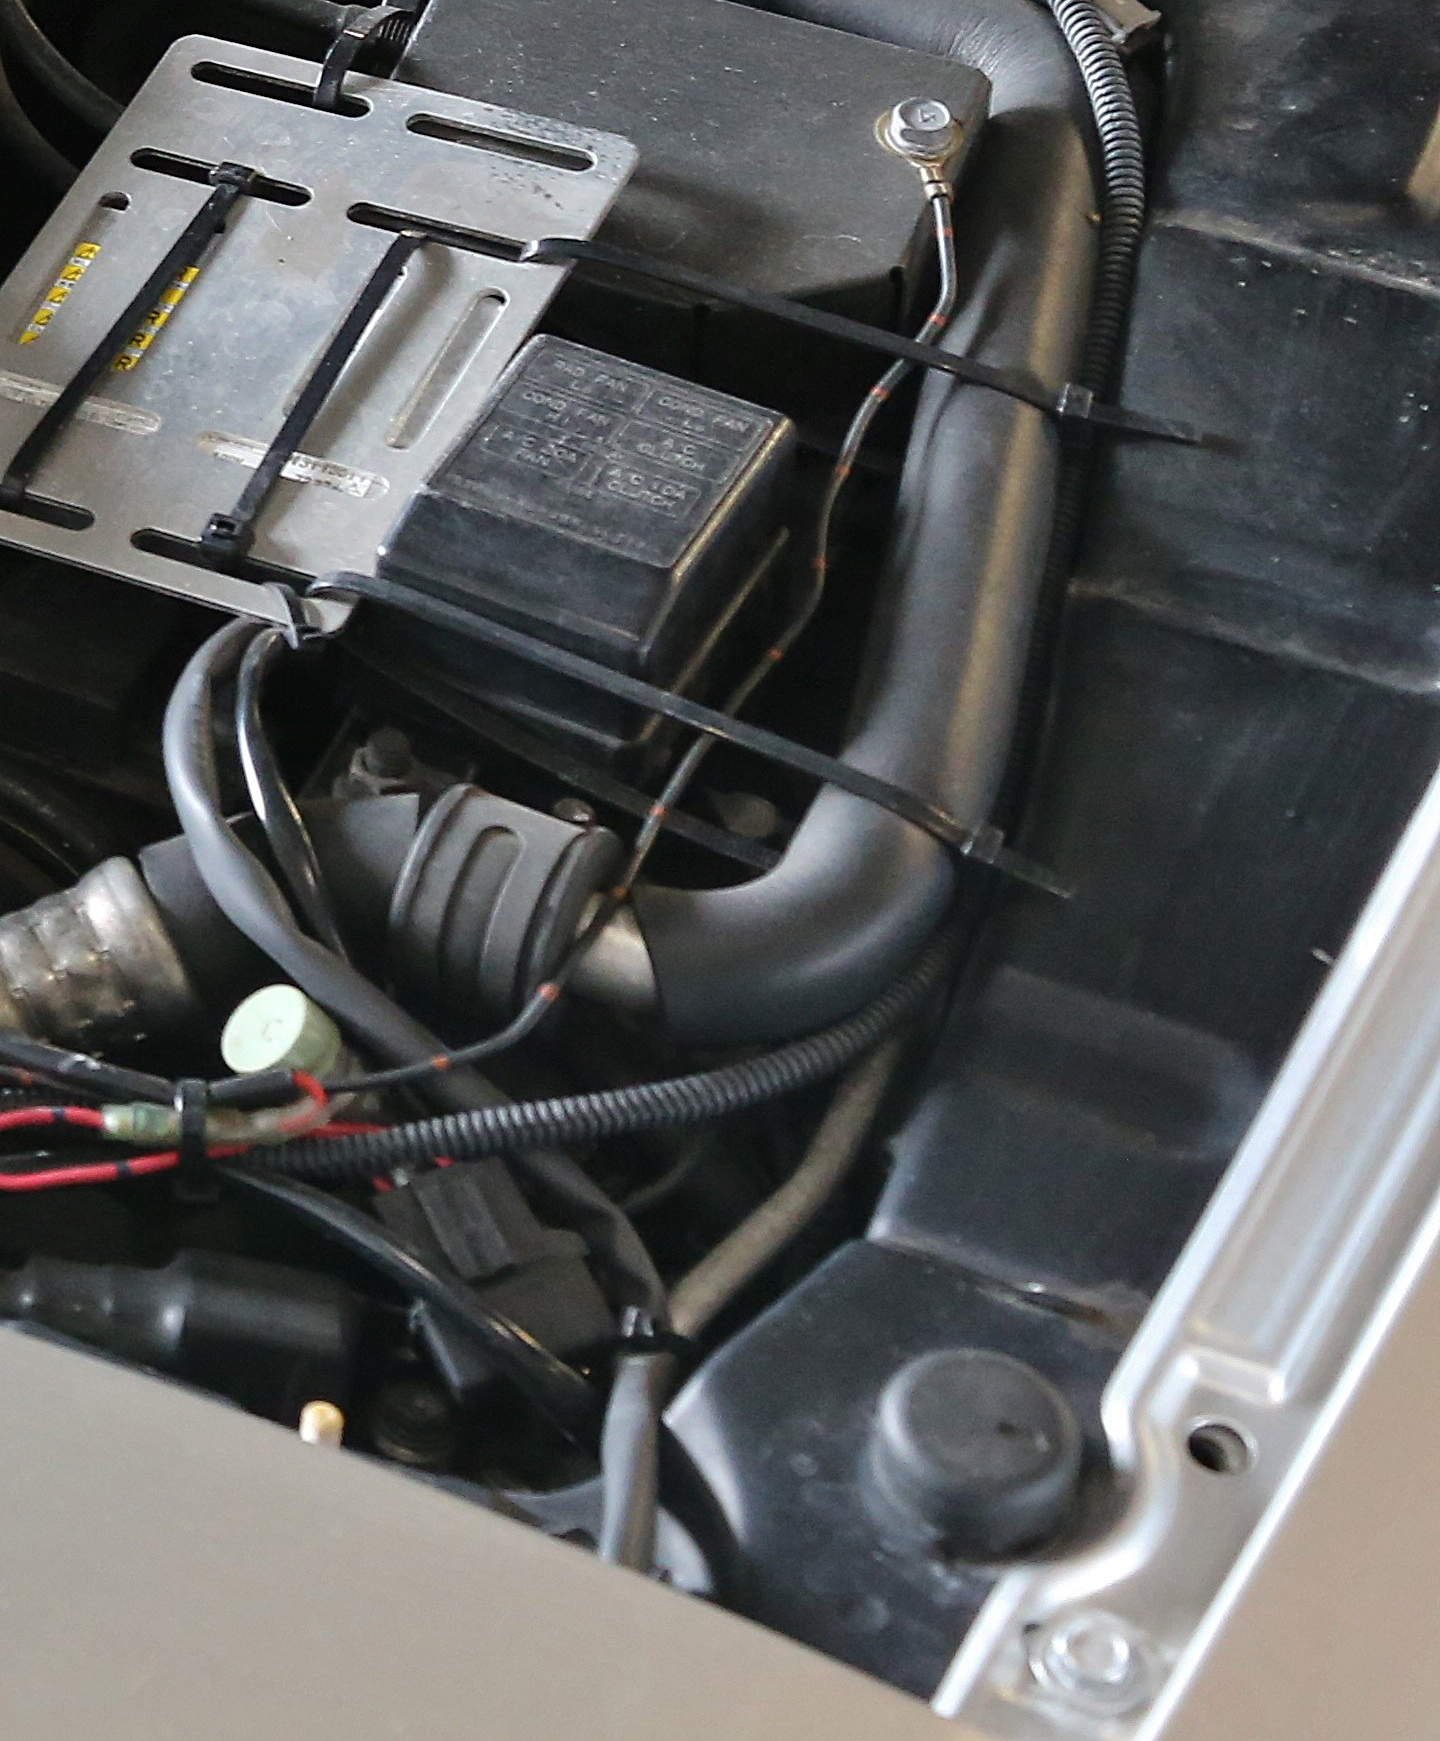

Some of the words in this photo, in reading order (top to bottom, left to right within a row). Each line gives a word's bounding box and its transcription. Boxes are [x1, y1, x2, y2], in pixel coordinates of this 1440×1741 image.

[594, 373, 629, 392] FAN
[575, 406, 612, 427] FAN
[710, 412, 749, 433] FAN
[516, 448, 551, 468] FAN
